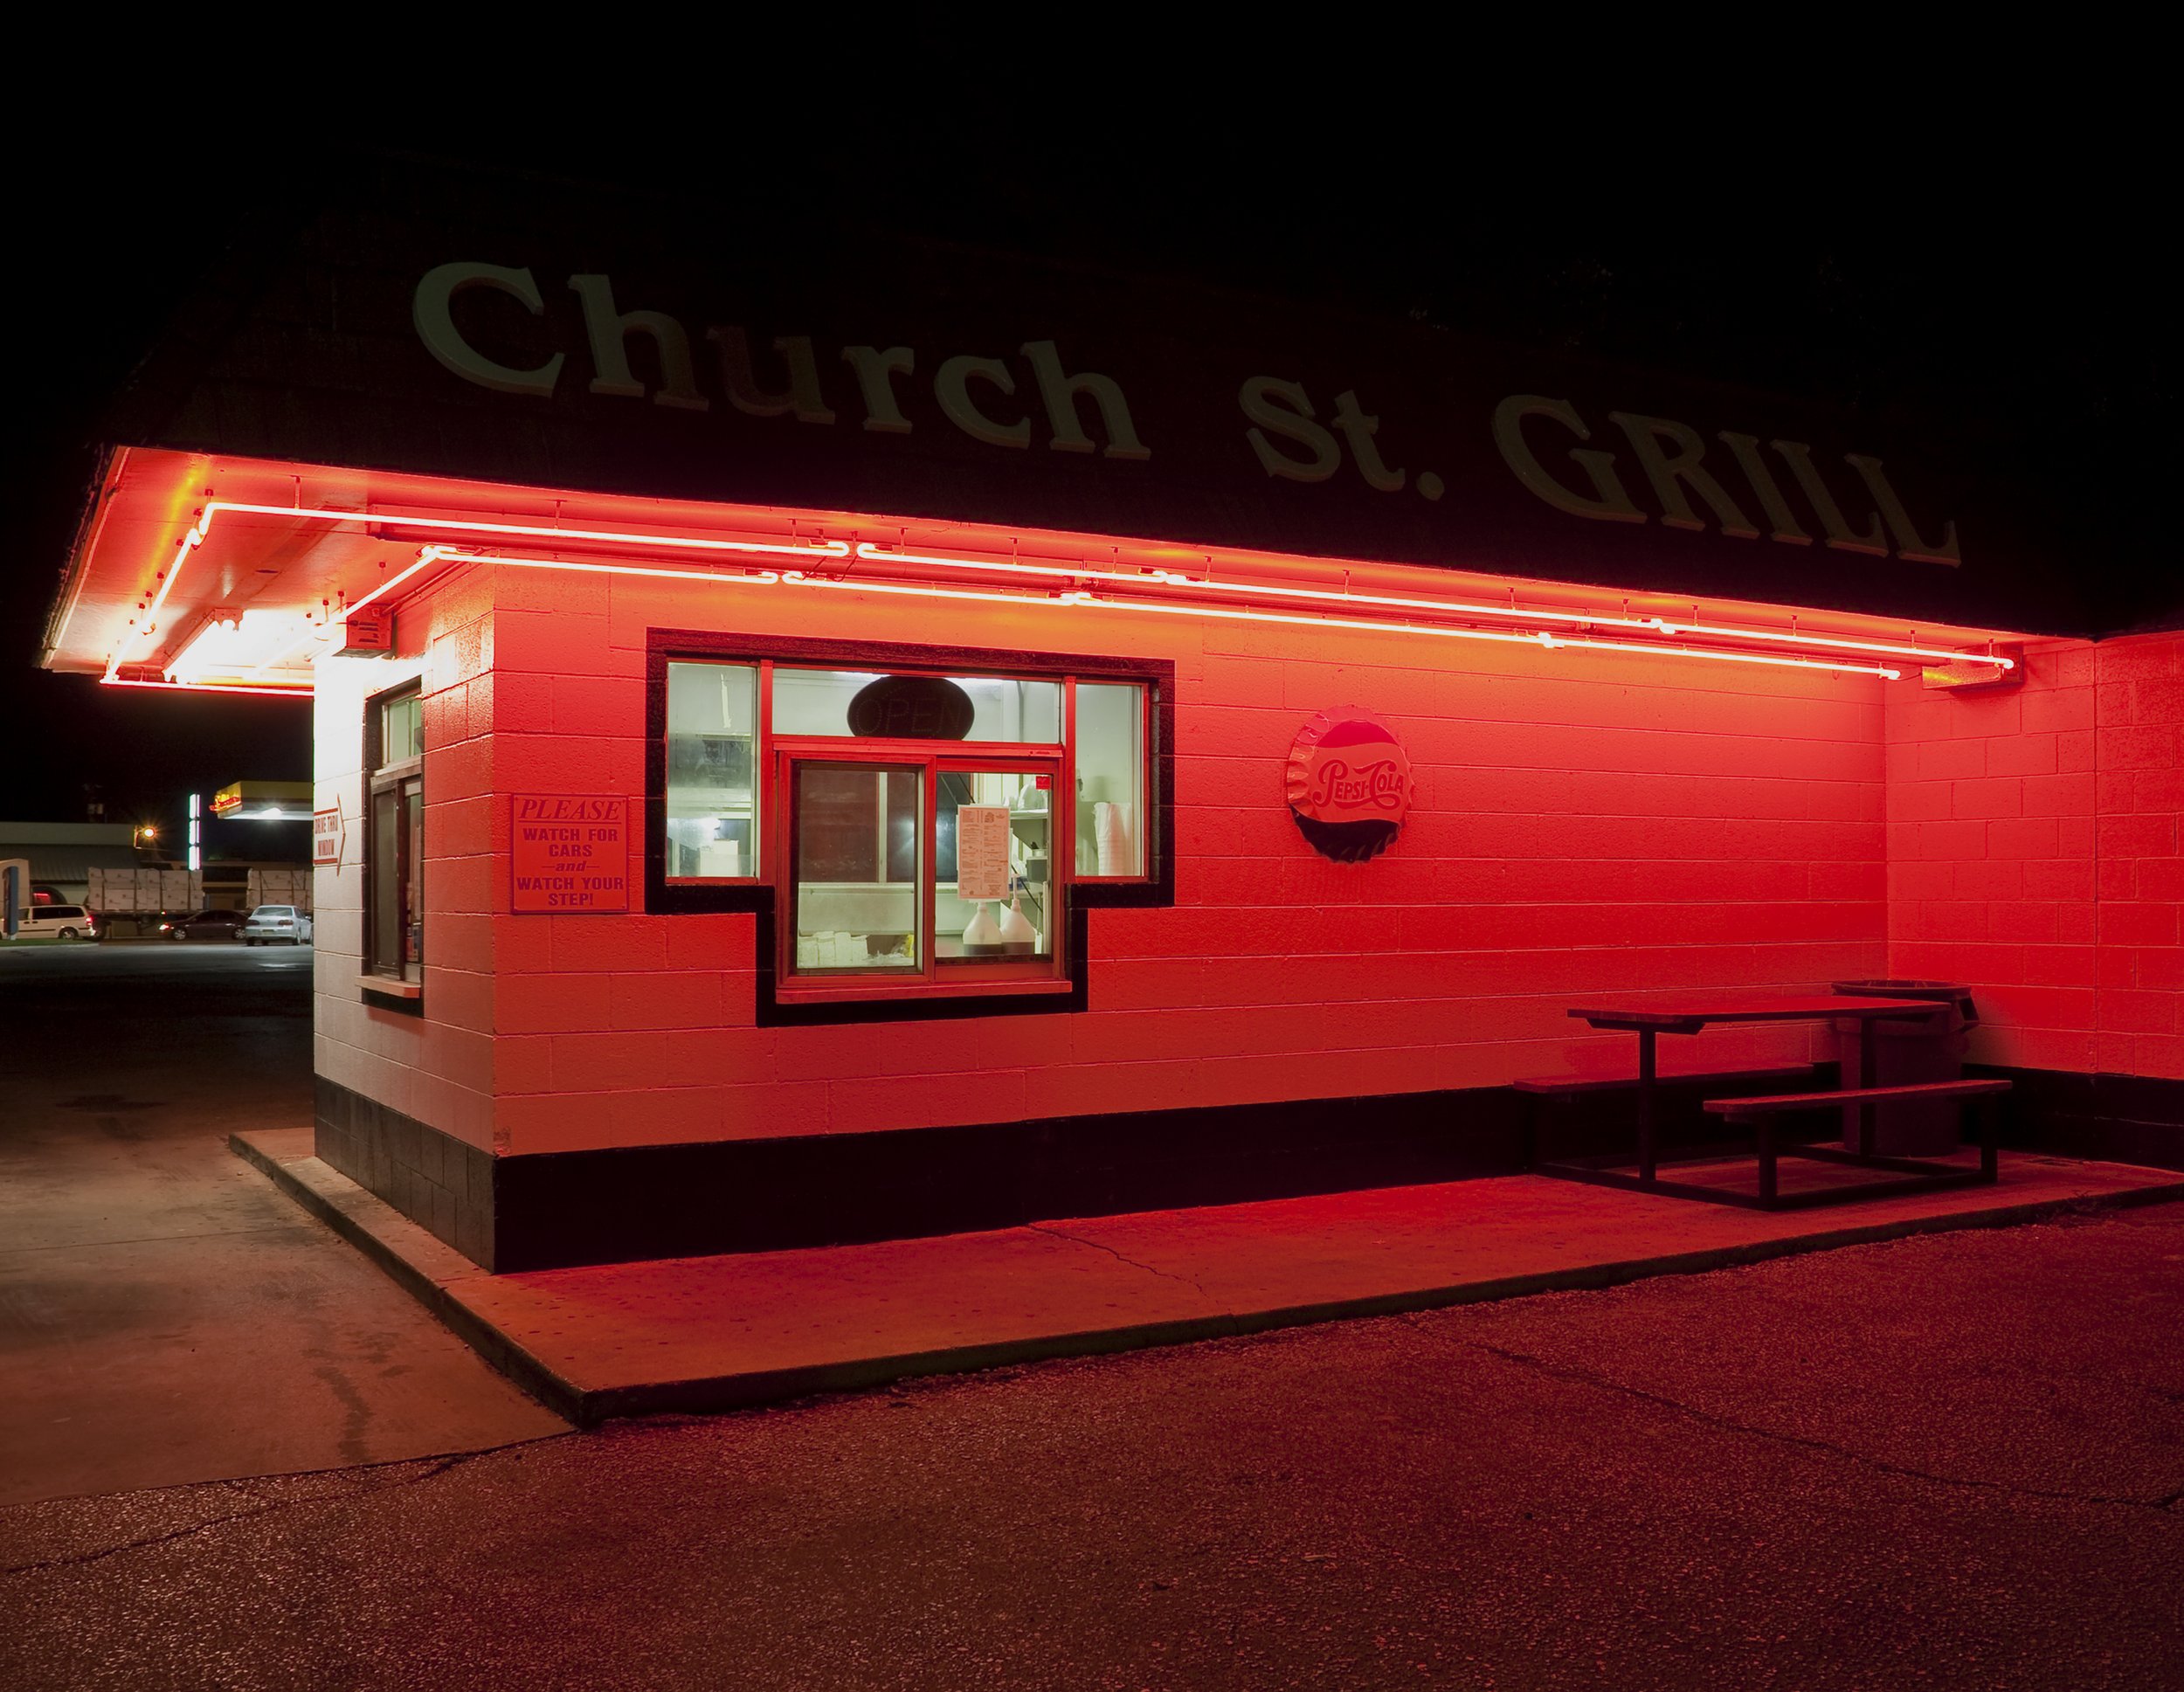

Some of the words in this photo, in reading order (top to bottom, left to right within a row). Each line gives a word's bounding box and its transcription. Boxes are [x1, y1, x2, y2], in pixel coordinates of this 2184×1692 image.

[411, 260, 1151, 461] Church
[1237, 376, 1445, 501] St.
[1491, 394, 1961, 569] GRILL
[855, 698, 962, 734] OPEN
[518, 798, 621, 820] PLEASE
[523, 828, 580, 841] WATCH
[588, 828, 618, 841] FOR
[549, 844, 592, 857] CARS
[556, 860, 587, 872] and
[516, 877, 574, 890] WATCH
[581, 877, 624, 890] YOUR
[549, 893, 593, 906] STEP!
